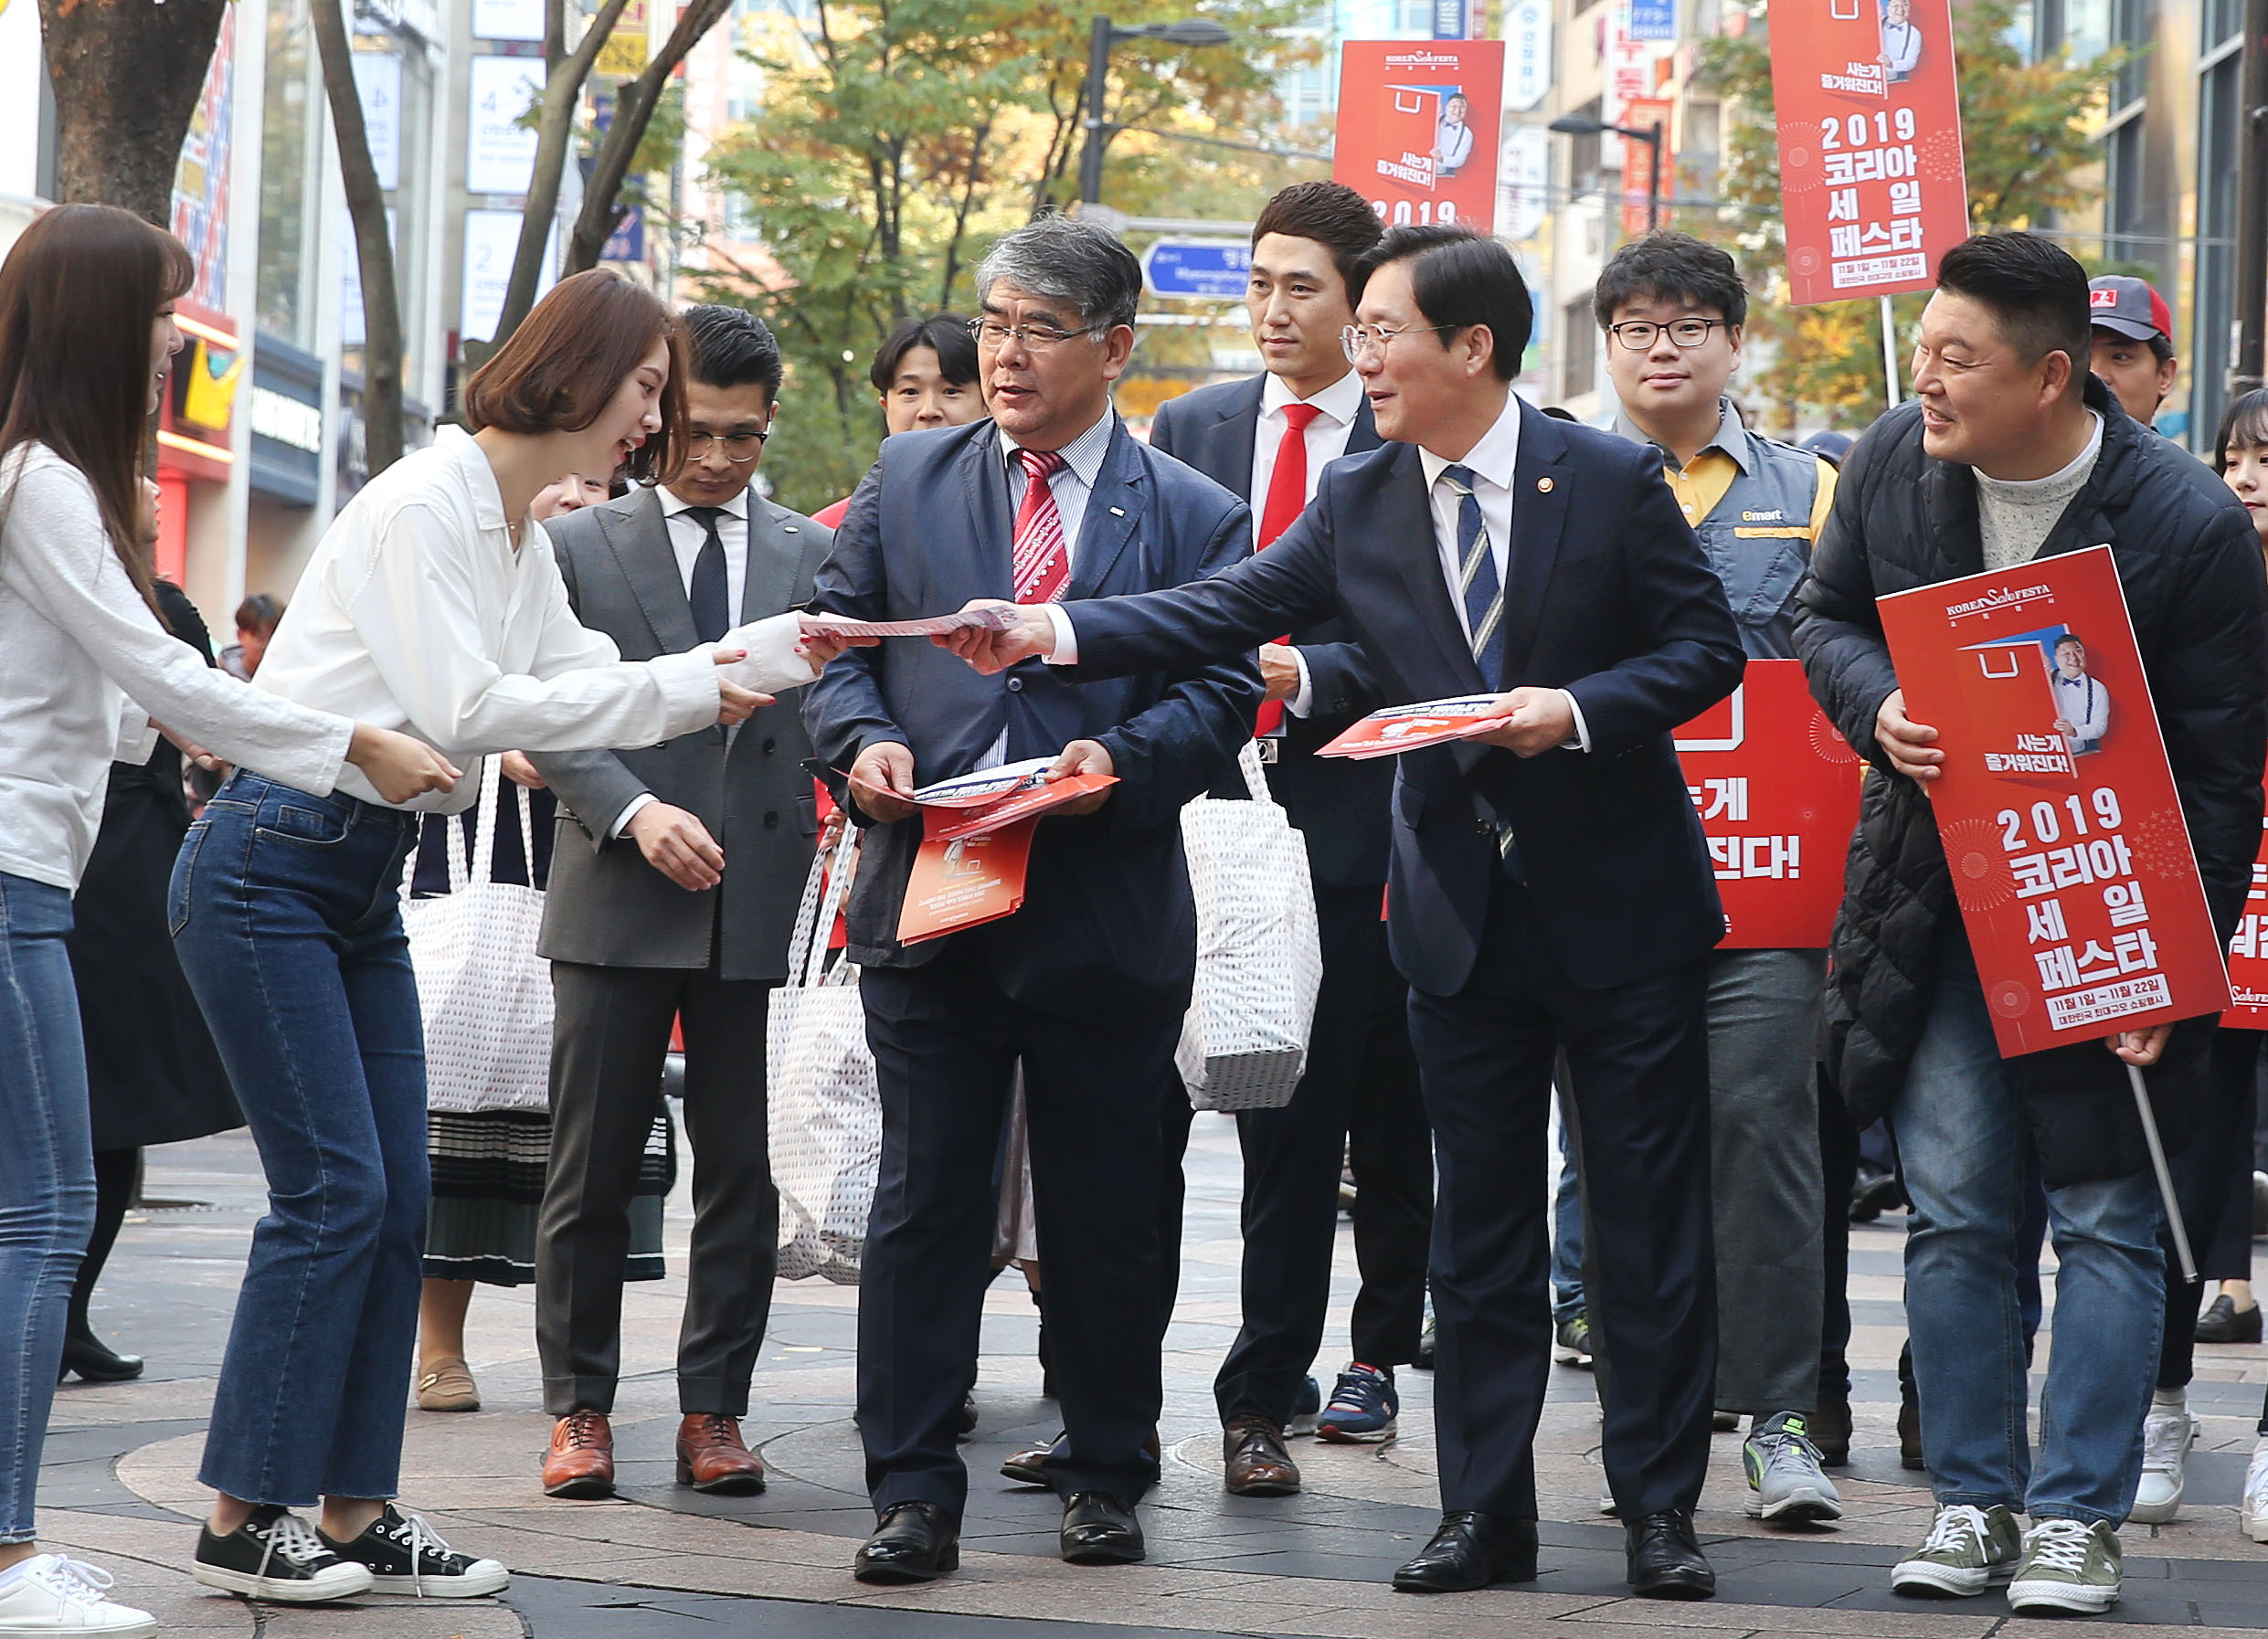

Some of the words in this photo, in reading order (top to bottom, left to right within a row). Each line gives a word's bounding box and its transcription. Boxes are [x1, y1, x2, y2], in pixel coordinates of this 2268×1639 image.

[1820, 73, 1883, 95] 즐거워진다!
[1846, 61, 1882, 80] 사는게
[1820, 107, 1917, 150] 2019
[1376, 159, 1432, 187] 즐거워진다!
[1400, 152, 1433, 173] 사는게
[1823, 144, 1918, 186] 코리아
[1372, 200, 1457, 227] 2019
[1828, 187, 1860, 222] 세
[1889, 180, 1923, 216] 일
[1829, 217, 1924, 259] 페스타
[1742, 509, 1783, 522] emart
[2015, 584, 2051, 600] FESTA
[2017, 734, 2065, 753] 사는게
[1984, 753, 2071, 773] 즐거워진다!
[1996, 787, 2123, 852] 2019
[2008, 833, 2134, 900] 코리아
[2025, 898, 2070, 945] 세
[2103, 880, 2150, 928] 일
[2033, 927, 2158, 992] 페스타
[2054, 996, 2077, 1012] 11월
[2079, 991, 2096, 1007] 1일
[2110, 985, 2132, 999] 11월
[2135, 978, 2160, 994] 22일
[2058, 1010, 2093, 1025] 대한민국
